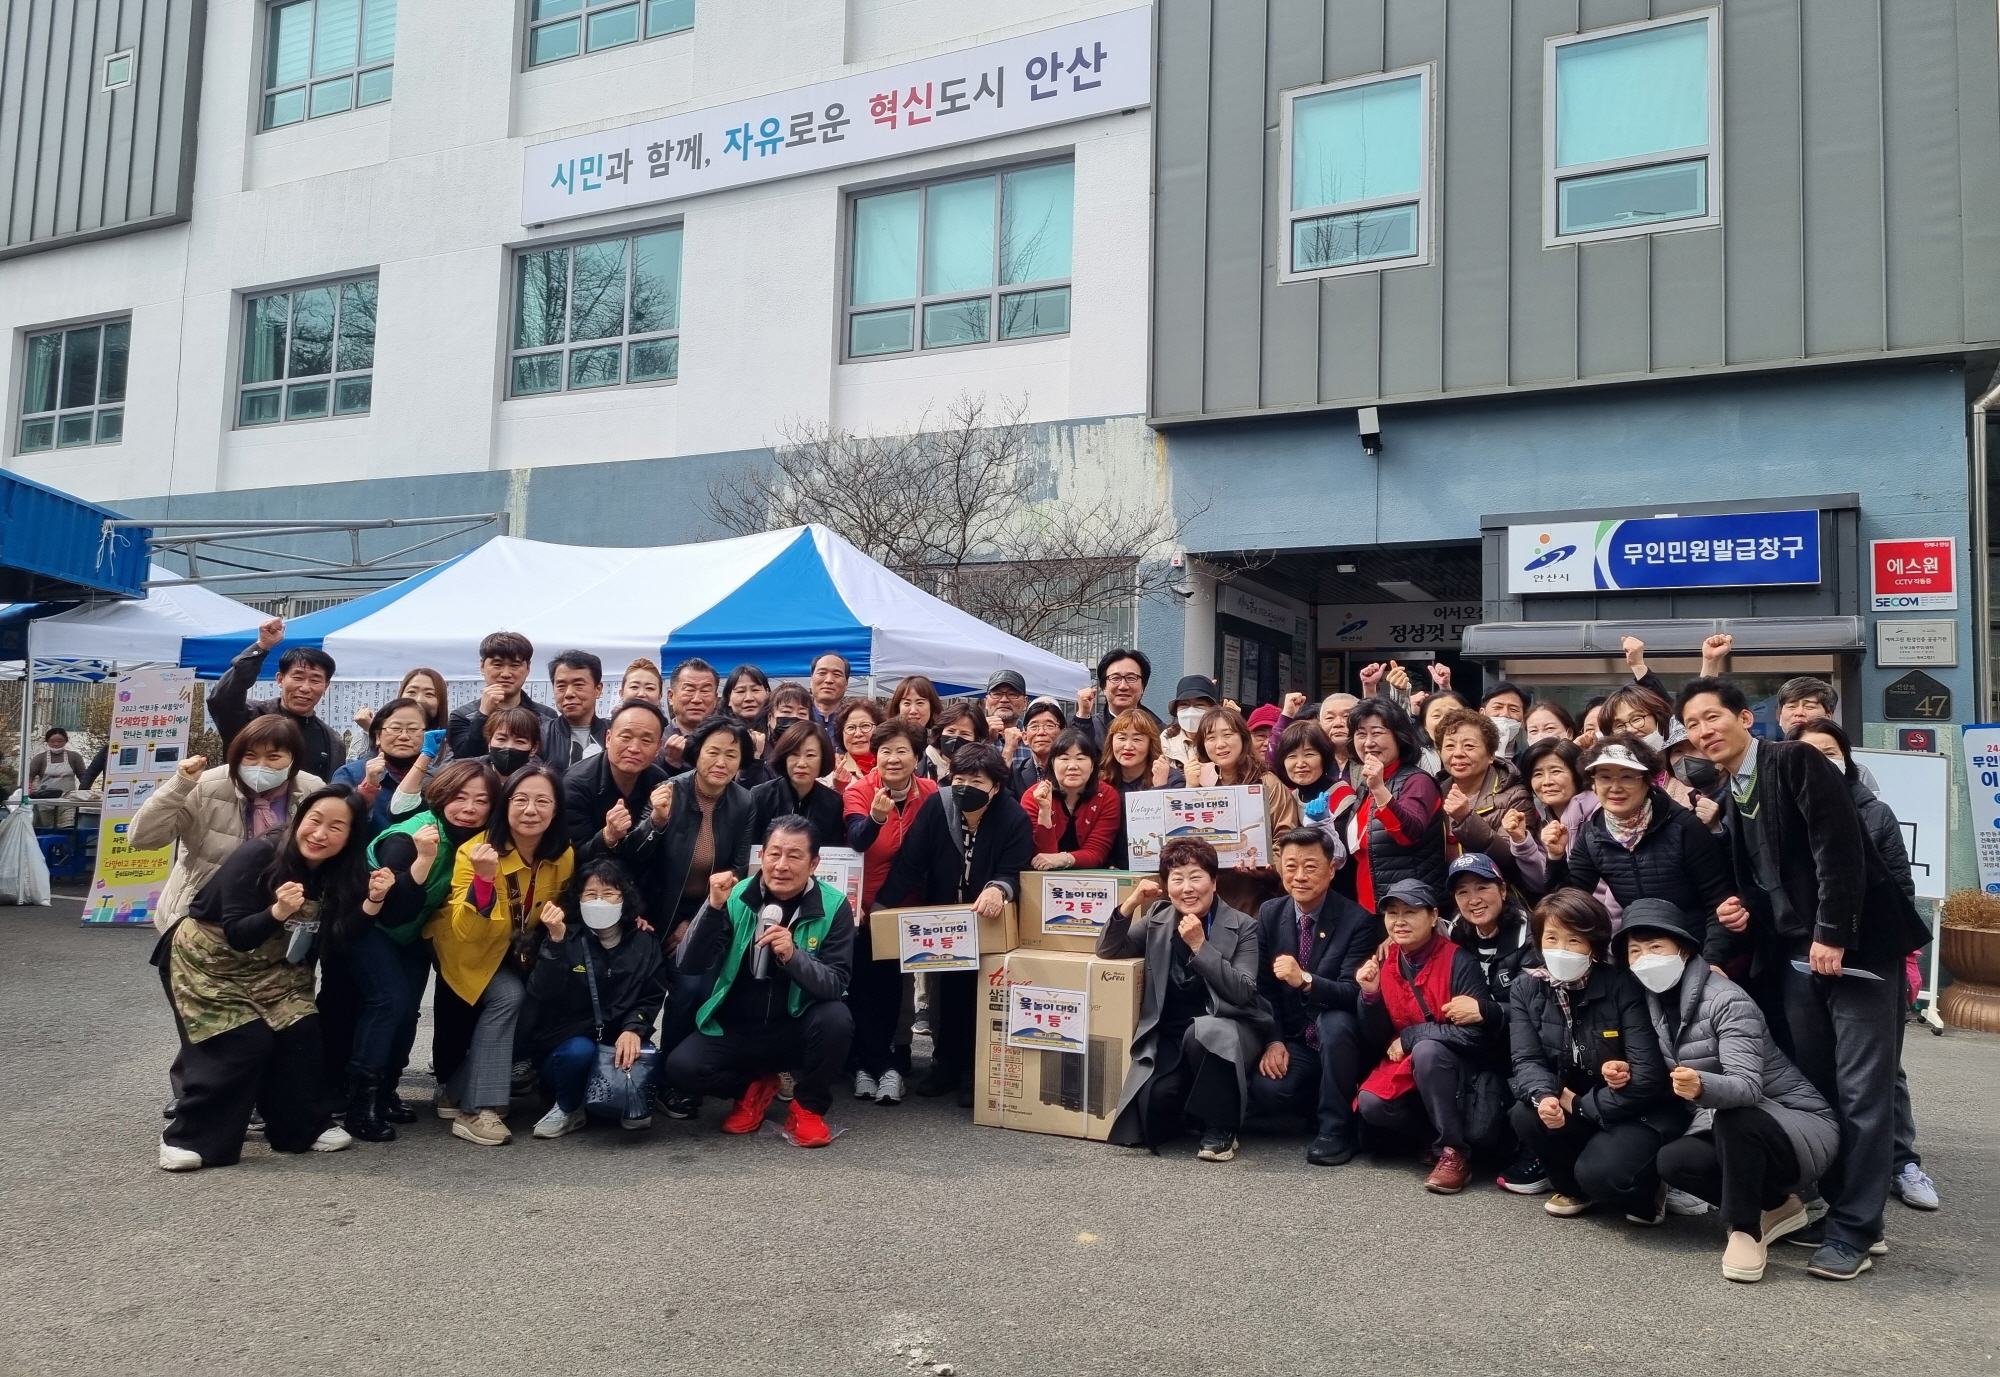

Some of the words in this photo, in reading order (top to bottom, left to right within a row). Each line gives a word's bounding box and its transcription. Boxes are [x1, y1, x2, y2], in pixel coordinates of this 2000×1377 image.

[550, 151, 633, 196] 시민과
[646, 132, 711, 180] 함께,
[722, 102, 851, 162] 자유로운
[868, 66, 1005, 131] 혁신도시
[1024, 41, 1108, 103] 안산
[1623, 536, 1804, 565] 무인민원발급창구
[1886, 557, 1939, 575] 에스원
[1532, 572, 1570, 583] 안산시
[1875, 597, 1919, 607] SECOM
[1389, 623, 1445, 644] 정성껏
[139, 703, 159, 712] 선부3동
[161, 702, 185, 711] 새봄맞이
[1914, 695, 1948, 717] 47
[115, 715, 149, 728] 단체화합
[152, 714, 189, 726] 윷놀이에서
[123, 730, 142, 739] 만나는
[144, 728, 164, 738] 특별한
[1206, 800, 1228, 808] 대회
[113, 836, 128, 844] 자전
[104, 860, 129, 869] 다양하고
[131, 859, 150, 868] 푸짐한
[151, 858, 169, 867] 상품이
[1086, 891, 1108, 899] 대회
[945, 925, 968, 933] 대회
[1101, 970, 1125, 982] Korea
[1055, 1003, 1078, 1014] 대회
